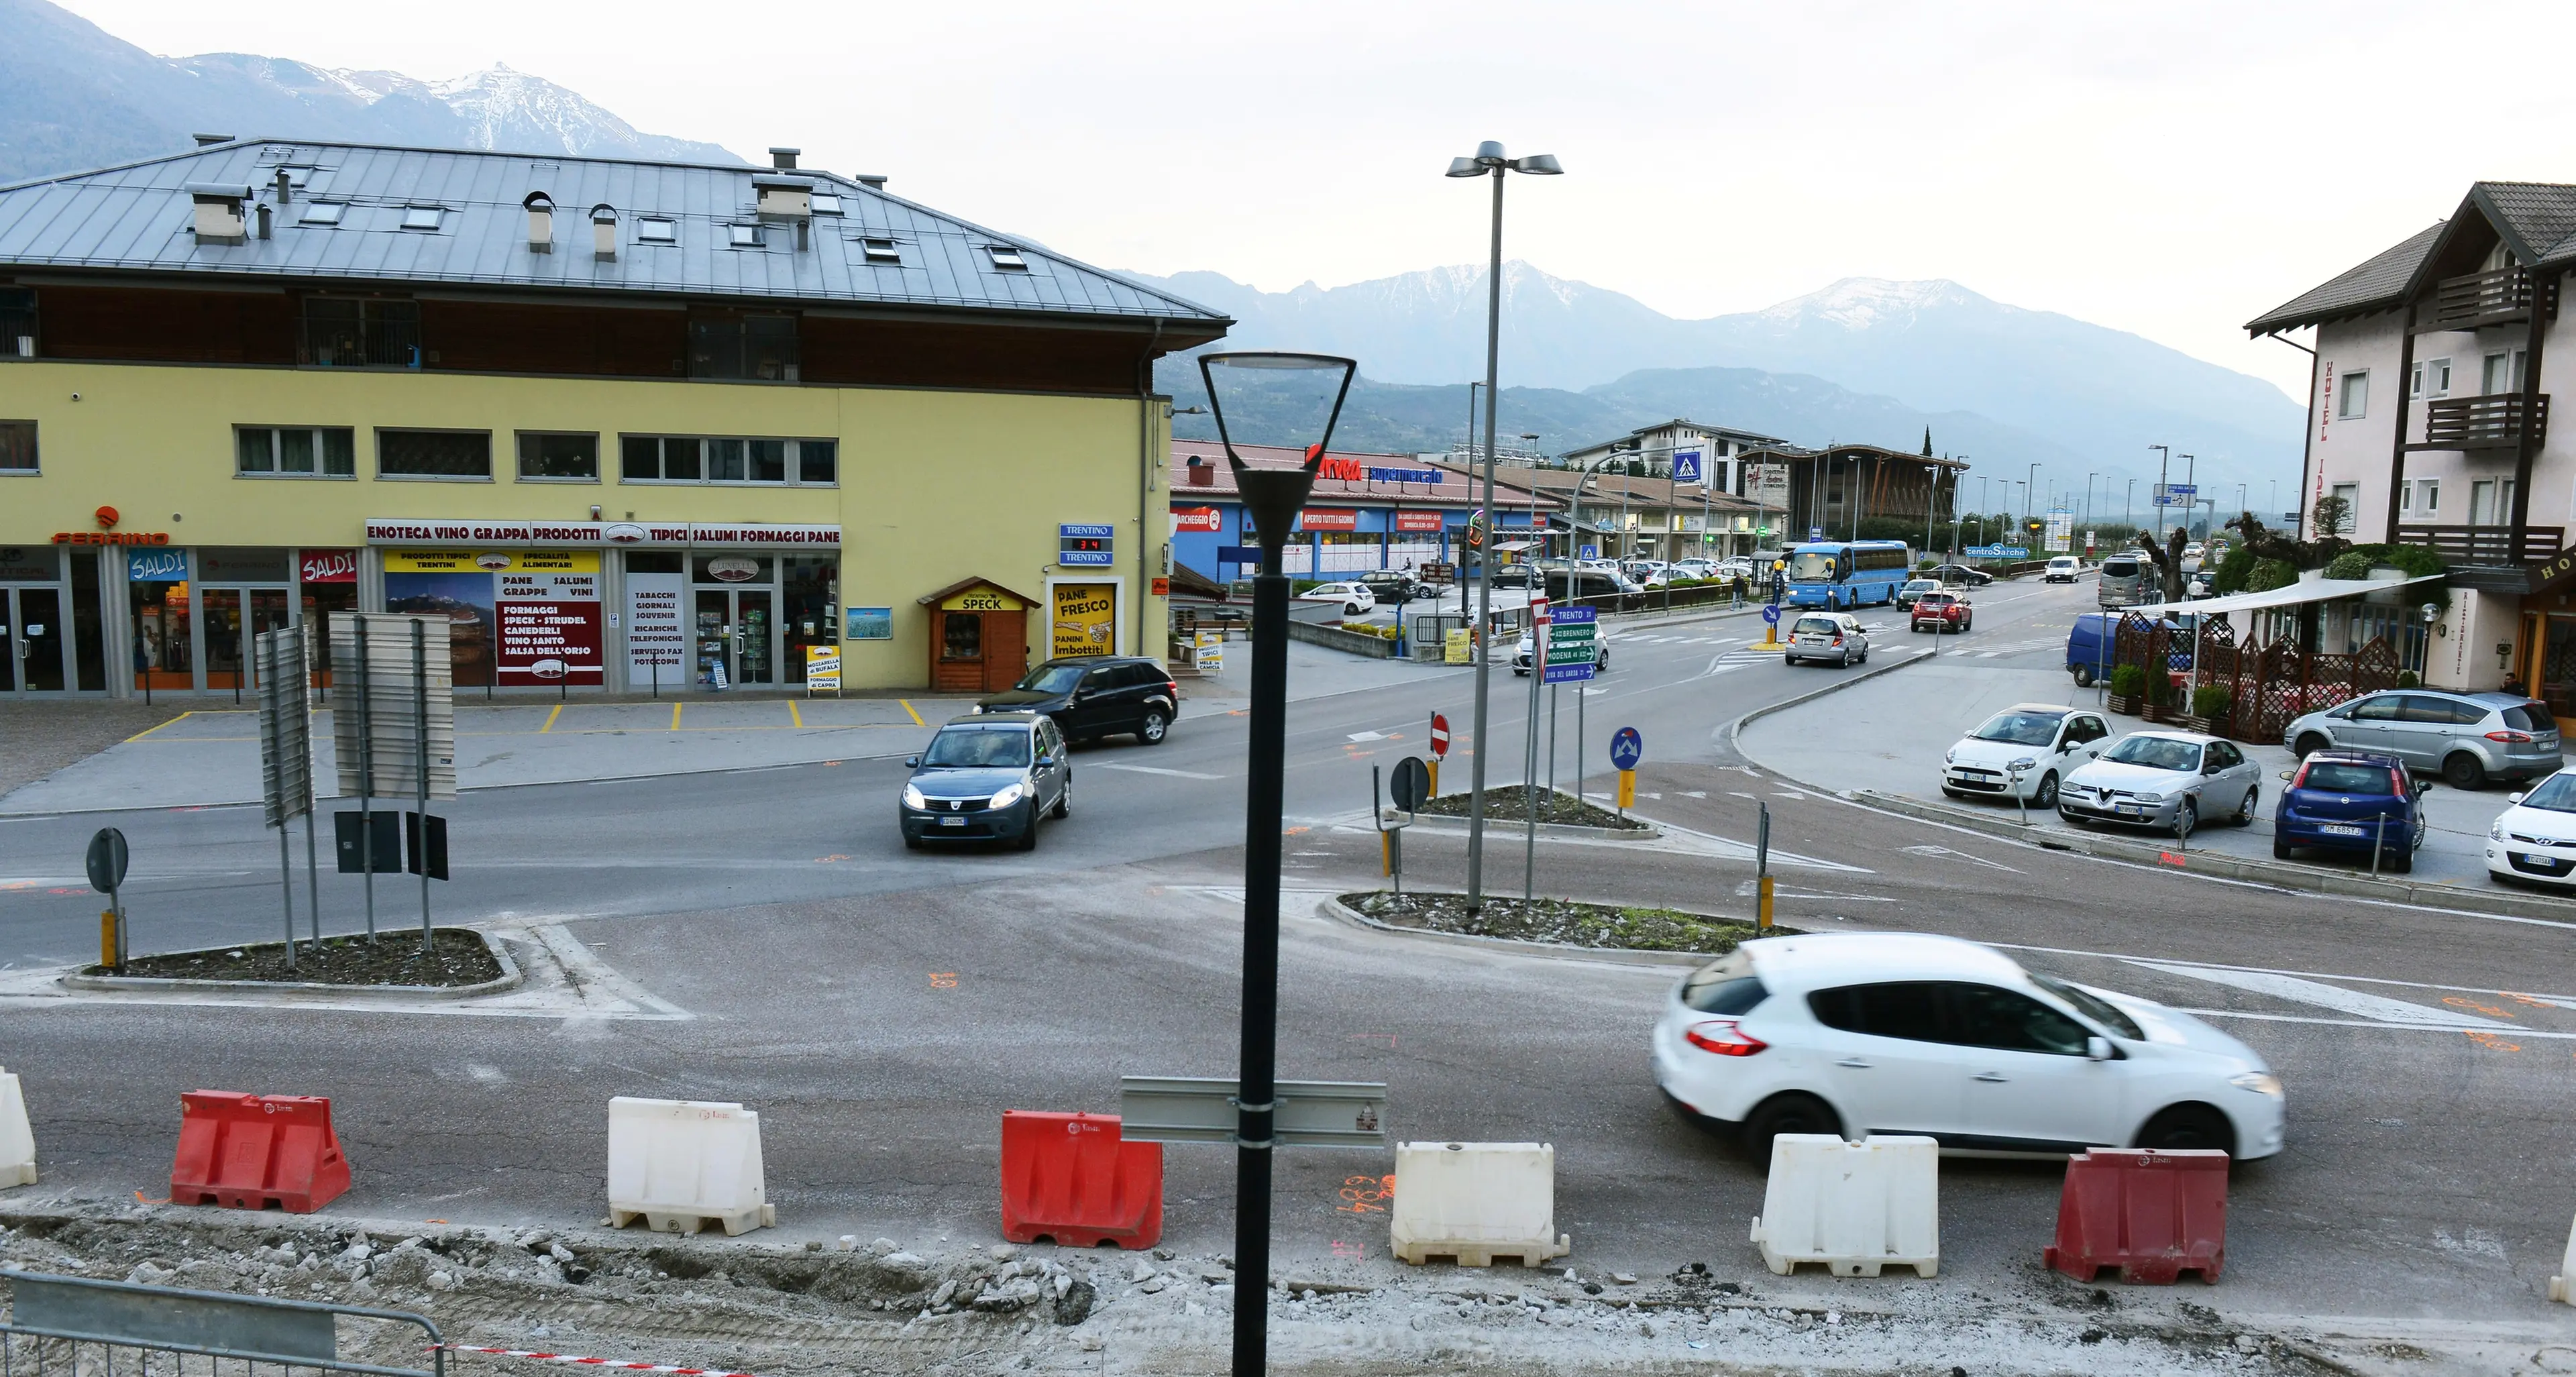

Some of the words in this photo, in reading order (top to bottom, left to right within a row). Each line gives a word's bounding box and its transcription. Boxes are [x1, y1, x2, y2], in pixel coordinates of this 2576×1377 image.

[2321, 362, 2333, 442] HOTEL
[1371, 467, 1443, 484] supermercato
[1177, 514, 1208, 525] ARCHEGGIO
[1304, 514, 1322, 524] APERTO
[1322, 515, 1335, 524] TUTTI
[1338, 515, 1354, 524] GIORNI
[367, 526, 432, 539] ENOTECA
[435, 527, 470, 539] VINO
[473, 527, 530, 540] GRAPPA
[533, 528, 600, 541] PRODOTTI
[650, 529, 688, 541] TIPICI
[693, 529, 737, 542] SALUMI
[741, 530, 806, 543] FORMAGGI
[808, 531, 840, 543] PANE
[1066, 526, 1108, 535] TRENTINO
[51, 533, 169, 545] FERRINO
[1966, 546, 2025, 557] centroSarche
[1066, 553, 1107, 562] TRENTINO
[132, 550, 185, 580] SALDI
[303, 552, 356, 581] SALDI
[2541, 552, 2576, 580] HO
[1058, 590, 1087, 602] PANE
[963, 599, 1002, 609] SPECK
[1060, 600, 1110, 617] FRESCO
[504, 616, 535, 624] SPECK
[544, 616, 586, 624] STRUDEL
[1558, 610, 1583, 620] TRENTO
[1562, 629, 1590, 637] BRENNERO
[1055, 635, 1083, 643] PANINI
[1055, 645, 1104, 655] Imbottiti
[1548, 651, 1572, 661] MODENA
[807, 659, 839, 668] MOZZARELLA
[816, 664, 839, 672] BUFALA
[2337, 826, 2360, 835] 685YJ
